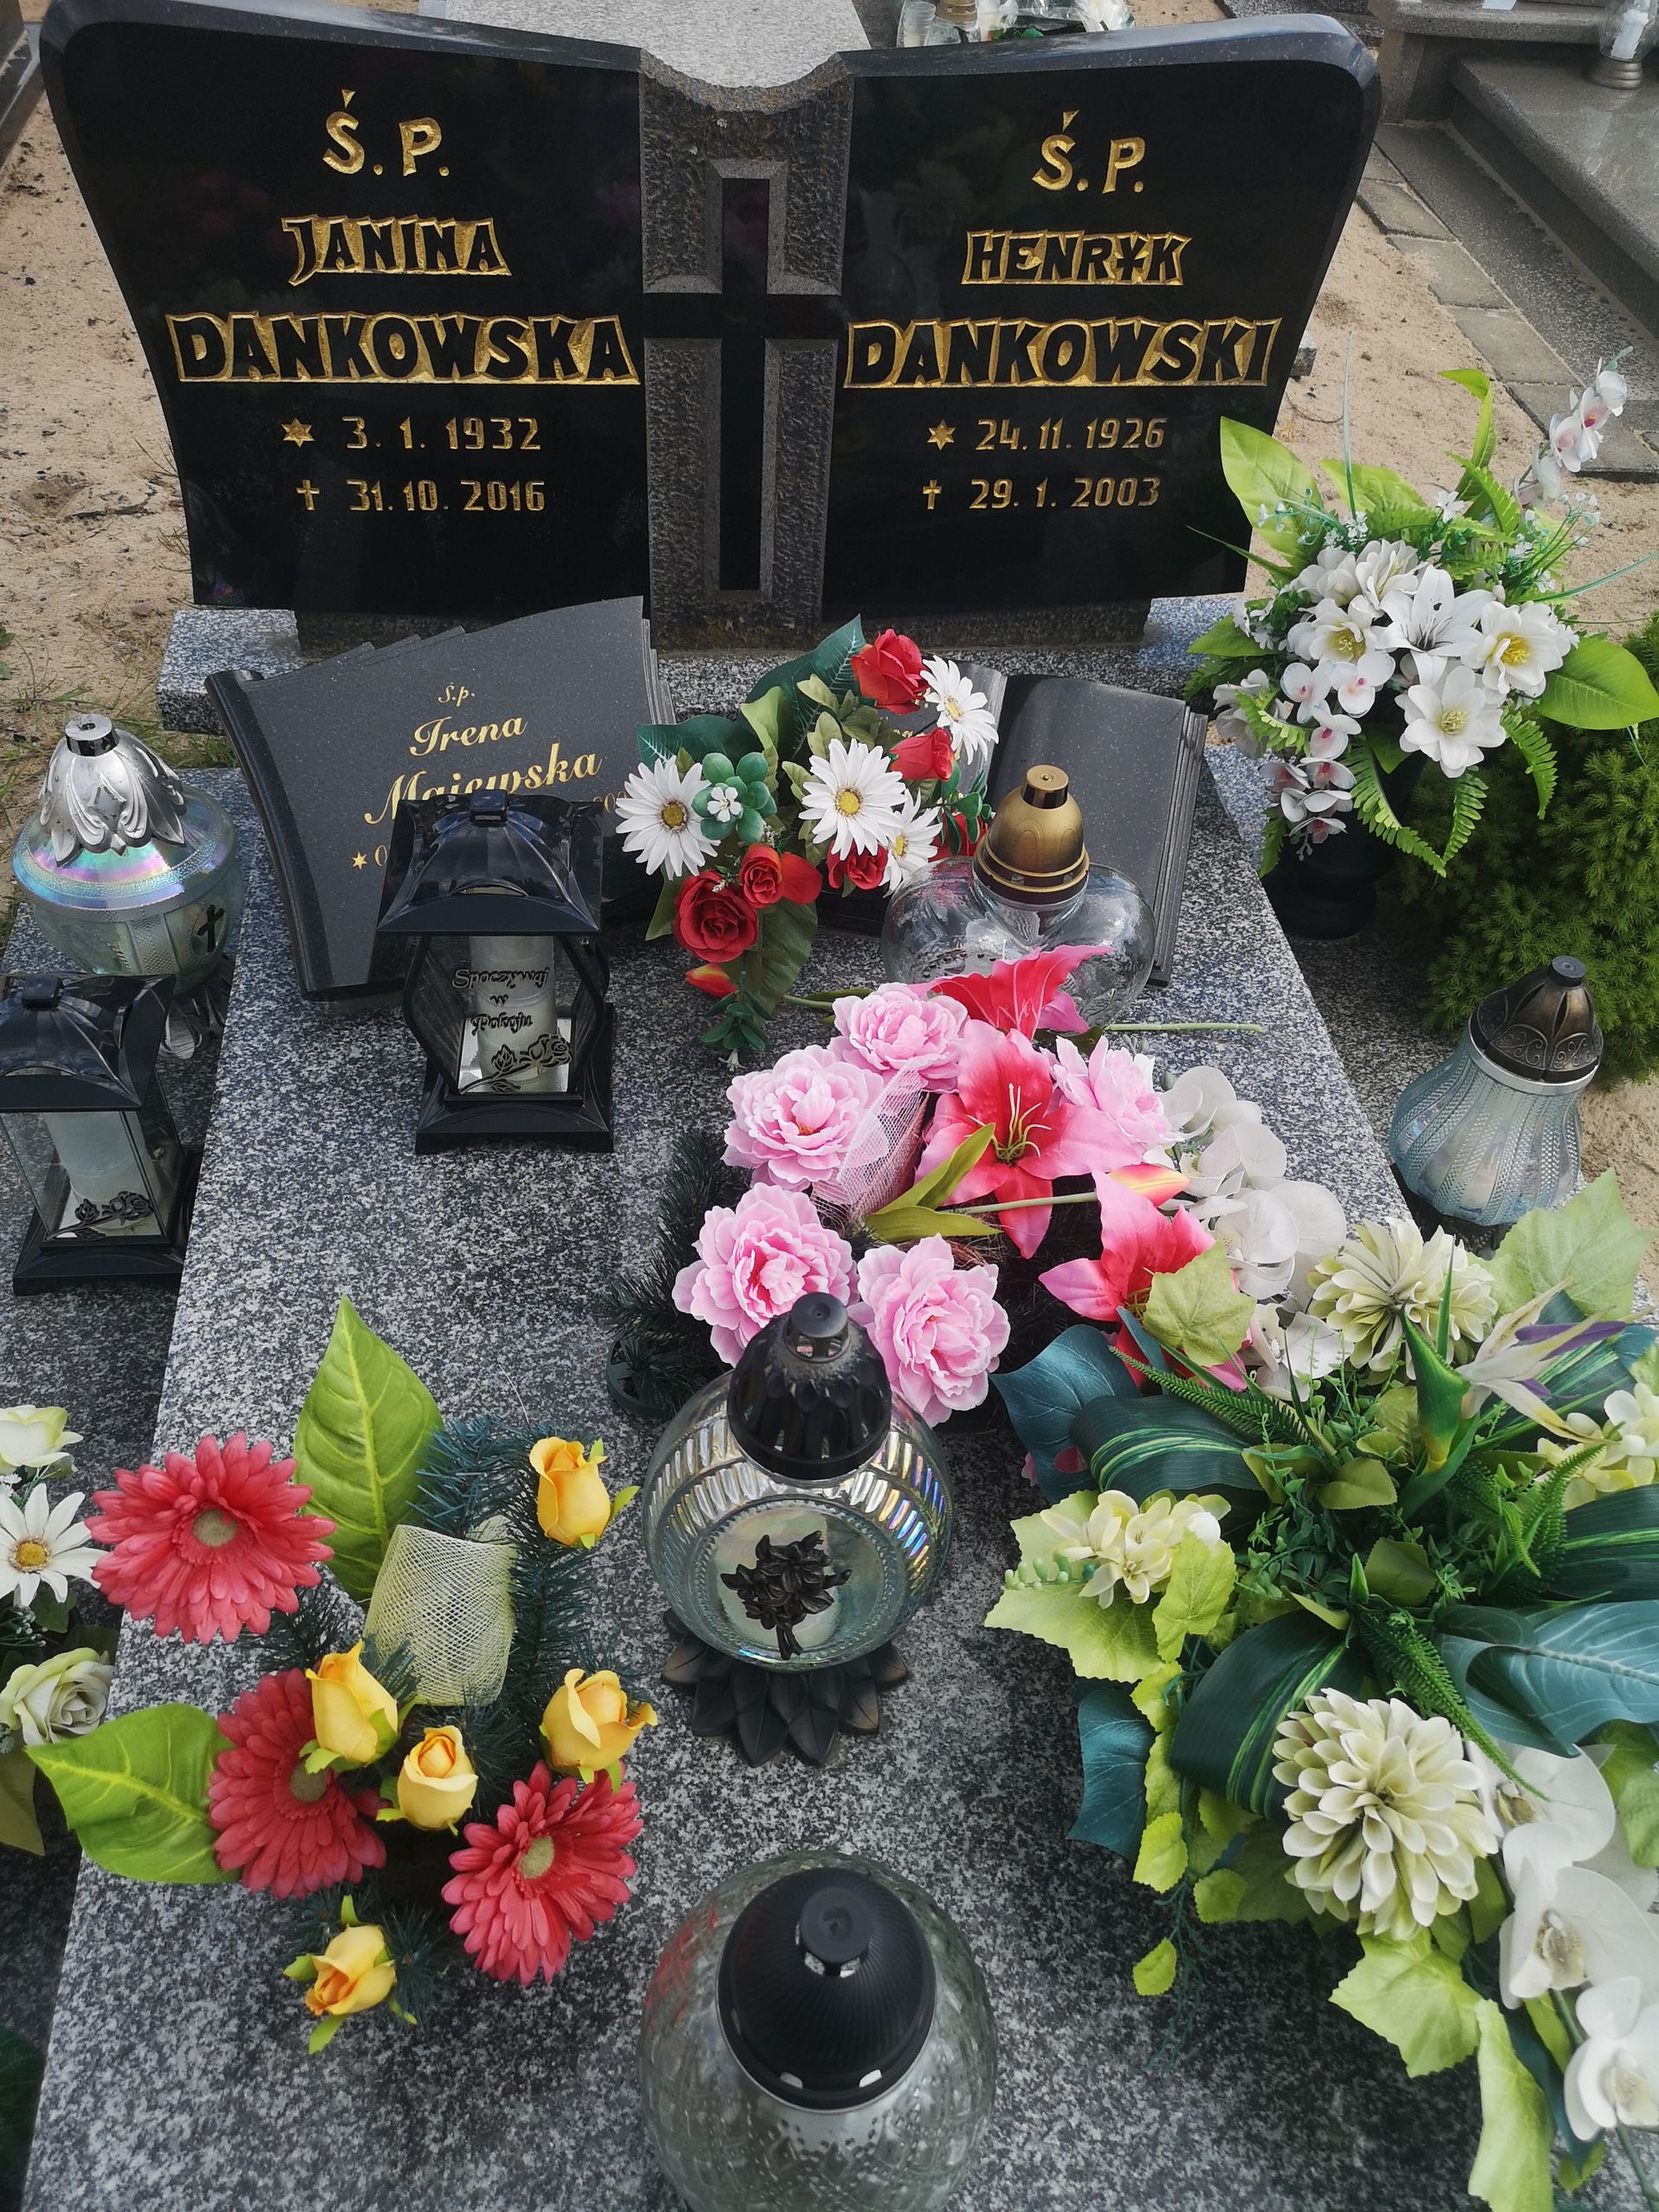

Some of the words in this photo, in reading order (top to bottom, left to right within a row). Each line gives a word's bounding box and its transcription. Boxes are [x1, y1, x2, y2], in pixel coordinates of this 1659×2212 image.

[322, 88, 384, 176] Ś.
[398, 116, 450, 177] P.
[1031, 109, 1089, 192] Ś.
[1100, 136, 1145, 194] P.
[280, 213, 513, 287] JANINA
[960, 229, 1193, 287] HENRYK
[165, 310, 642, 385] DANKOWSKA
[843, 314, 1283, 389] DANKOWSKI
[444, 417, 541, 451] 1932
[1085, 417, 1167, 450] 1926
[460, 479, 546, 513] 2016
[1073, 476, 1161, 508] 2003
[408, 715, 529, 758] Irena
[451, 967, 551, 990] Spoczywaj
[470, 1011, 534, 1038] Pokoju
